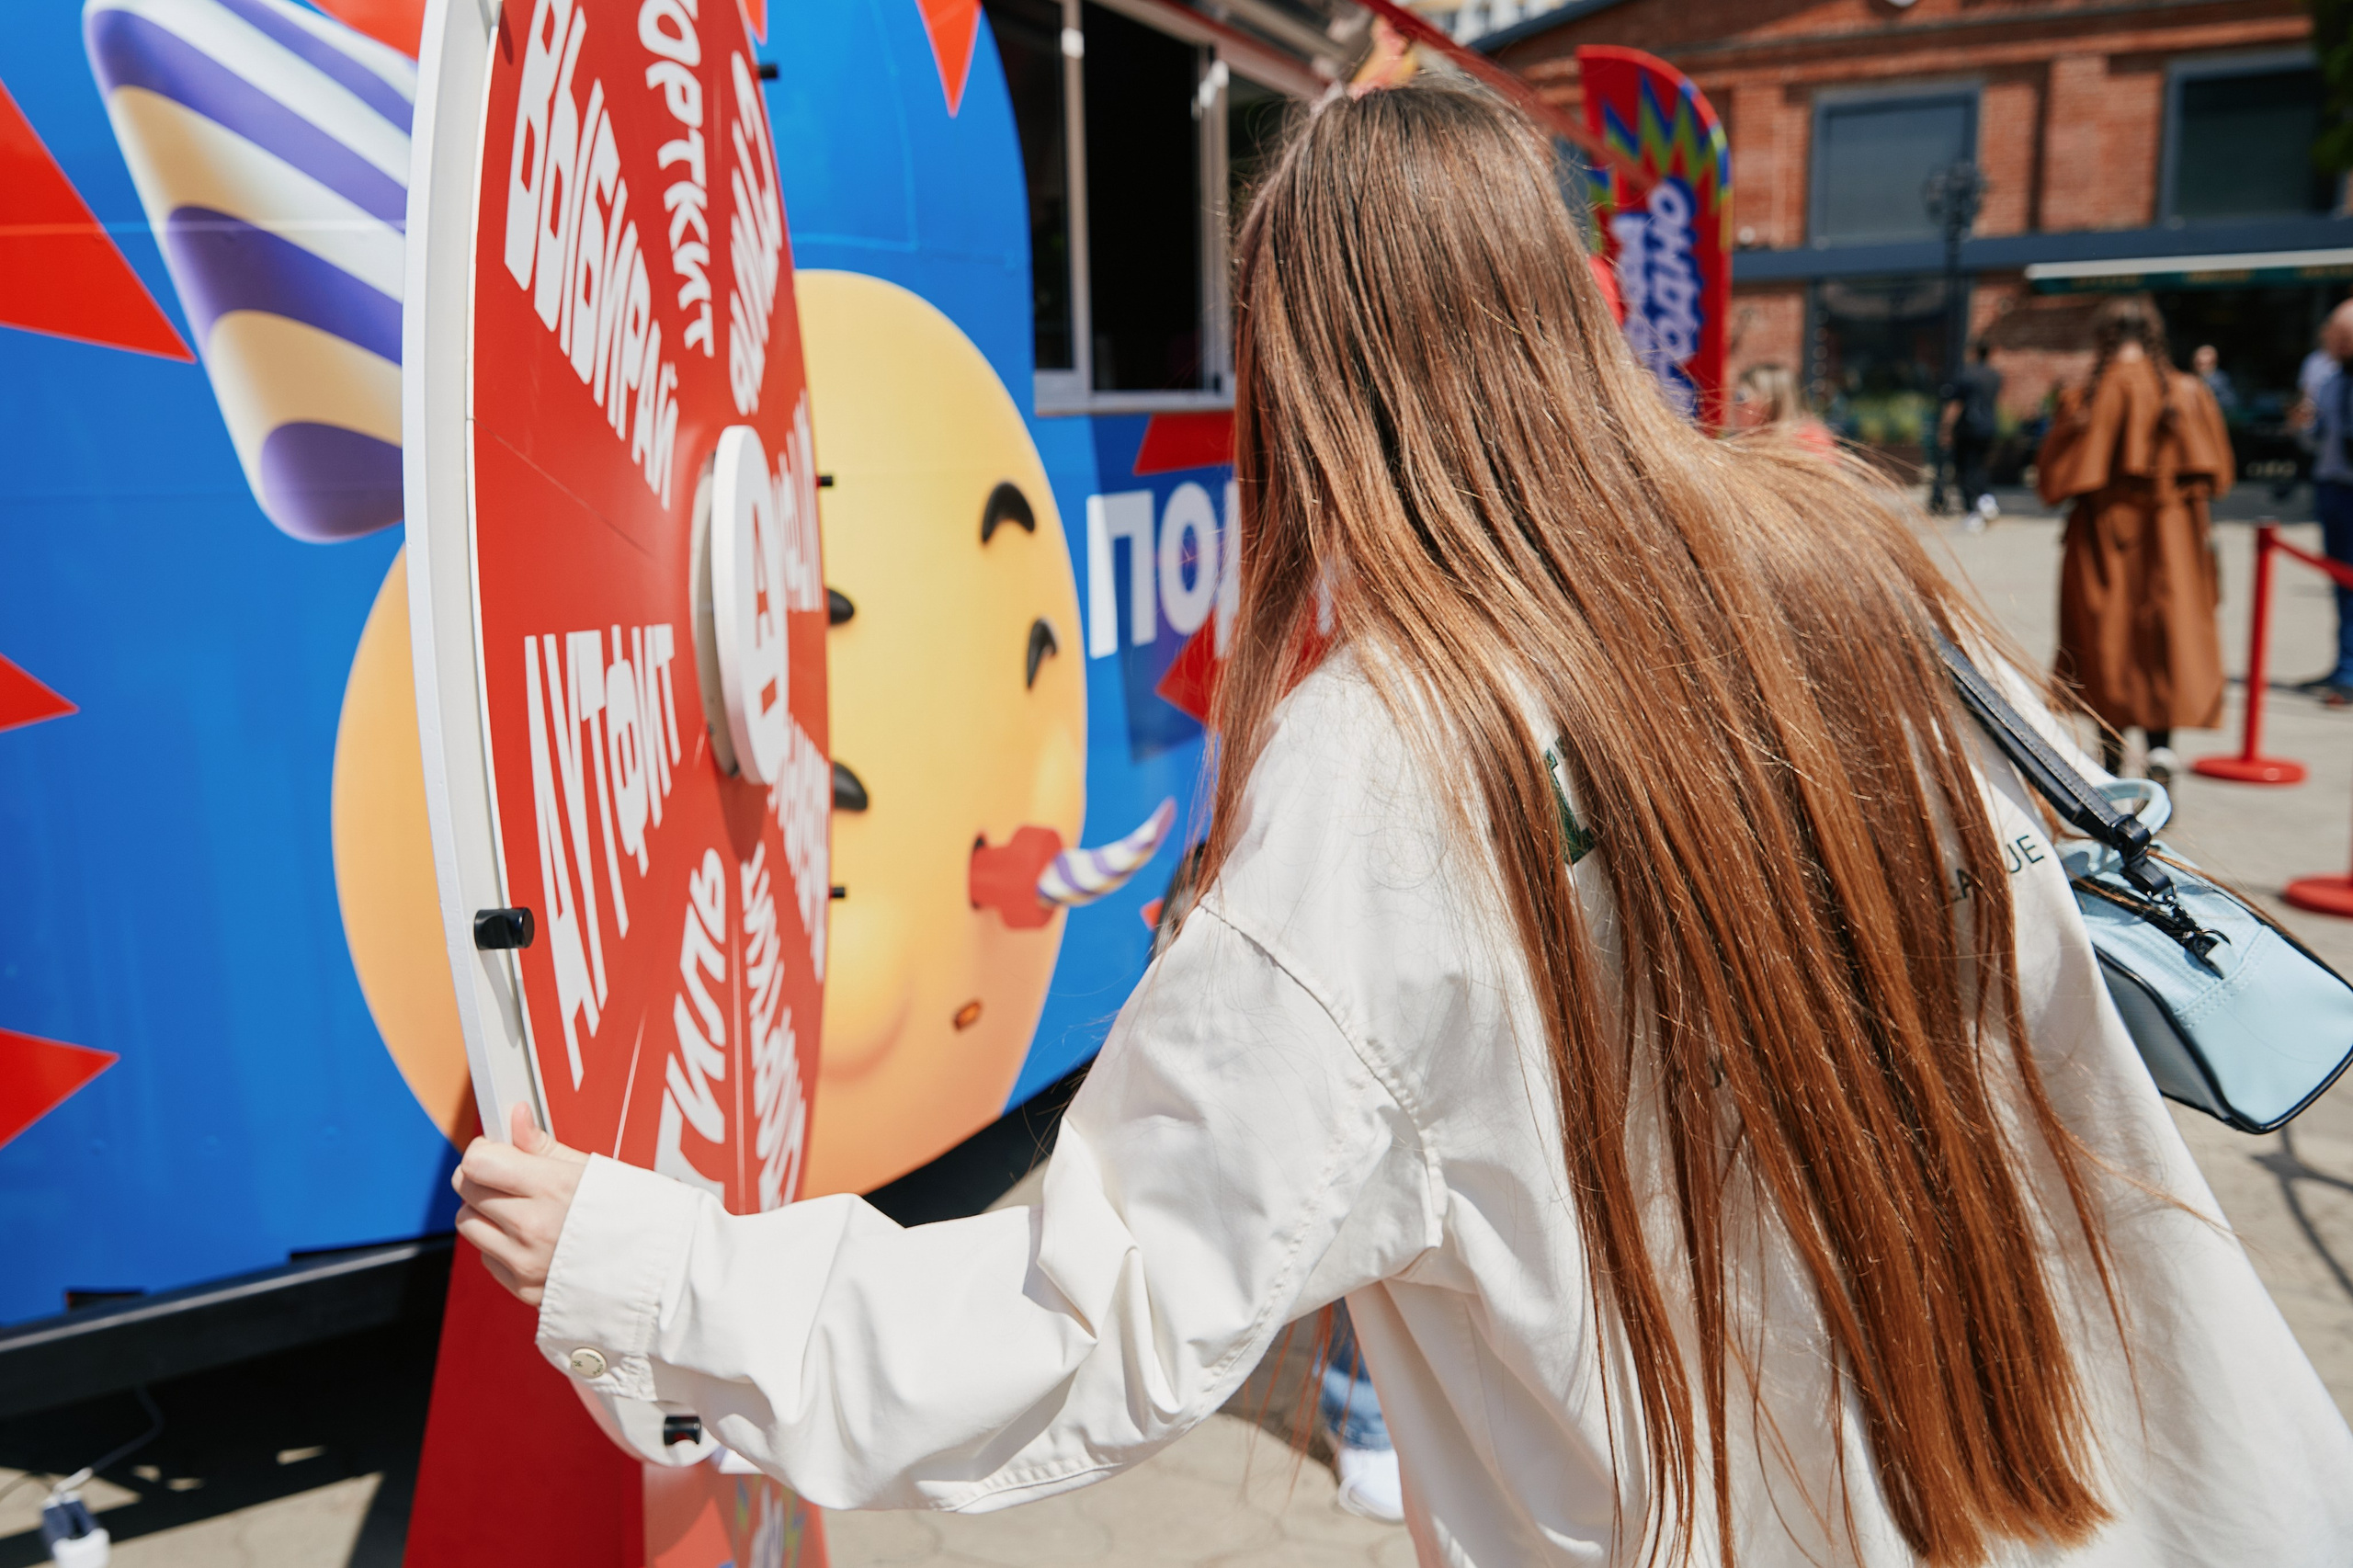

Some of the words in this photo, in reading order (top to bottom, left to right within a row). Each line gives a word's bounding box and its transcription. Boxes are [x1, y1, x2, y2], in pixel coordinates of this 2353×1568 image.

[505, 0, 678, 511] ВЫБИРАЙ
[638, 0, 715, 358] ОРТКИТ
[525, 623, 682, 1092] АУТФИТ
[654, 847, 725, 1197] ТИЛЬ
